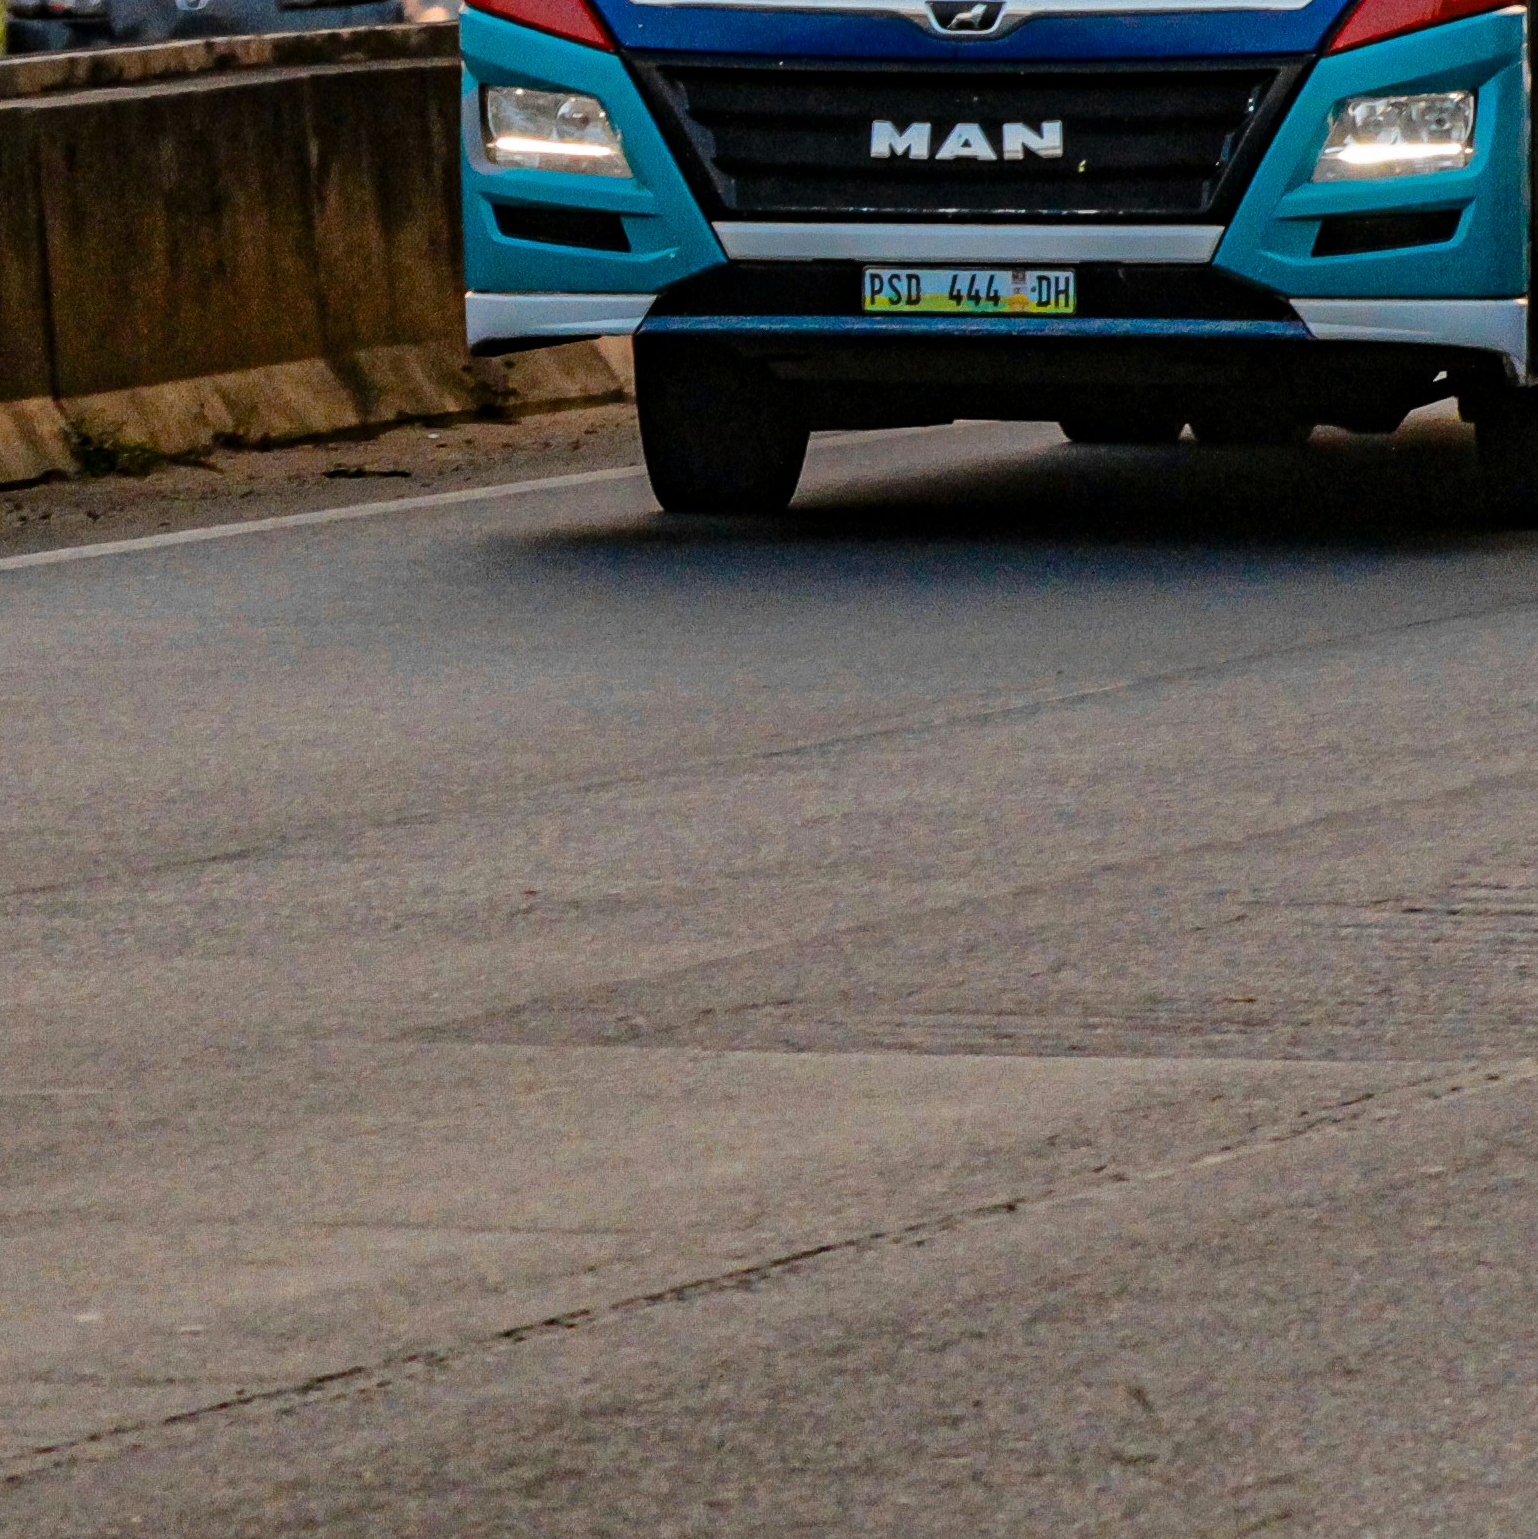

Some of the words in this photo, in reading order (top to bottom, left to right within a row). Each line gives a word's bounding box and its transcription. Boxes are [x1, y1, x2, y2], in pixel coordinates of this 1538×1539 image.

[870, 119, 1064, 161] MAN
[868, 273, 922, 306] PSD
[948, 273, 1001, 307] 444
[1035, 274, 1071, 308] DH
